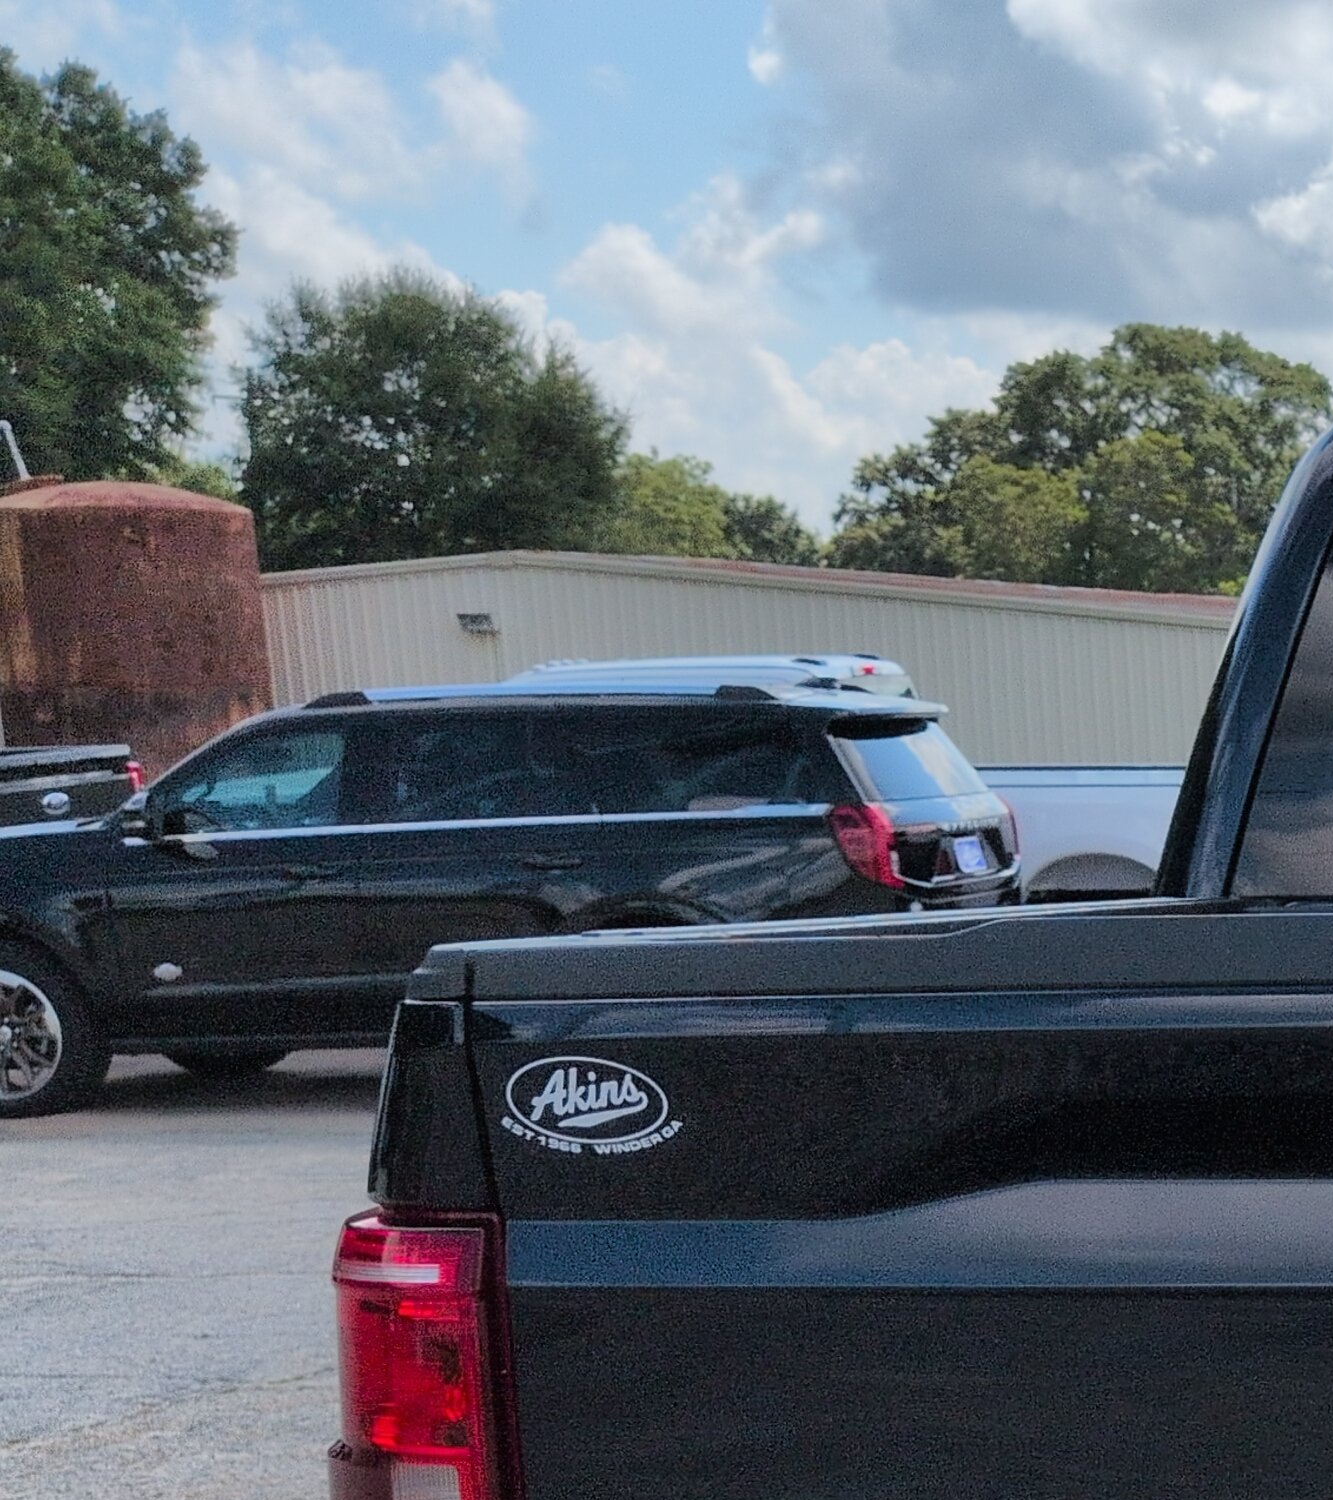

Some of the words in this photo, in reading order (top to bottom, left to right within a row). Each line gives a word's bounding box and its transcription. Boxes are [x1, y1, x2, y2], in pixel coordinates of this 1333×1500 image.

[529, 1067, 645, 1121] Akins
[501, 1116, 536, 1141] EST
[593, 1135, 664, 1154] WINDER
[660, 1119, 684, 1139] GA
